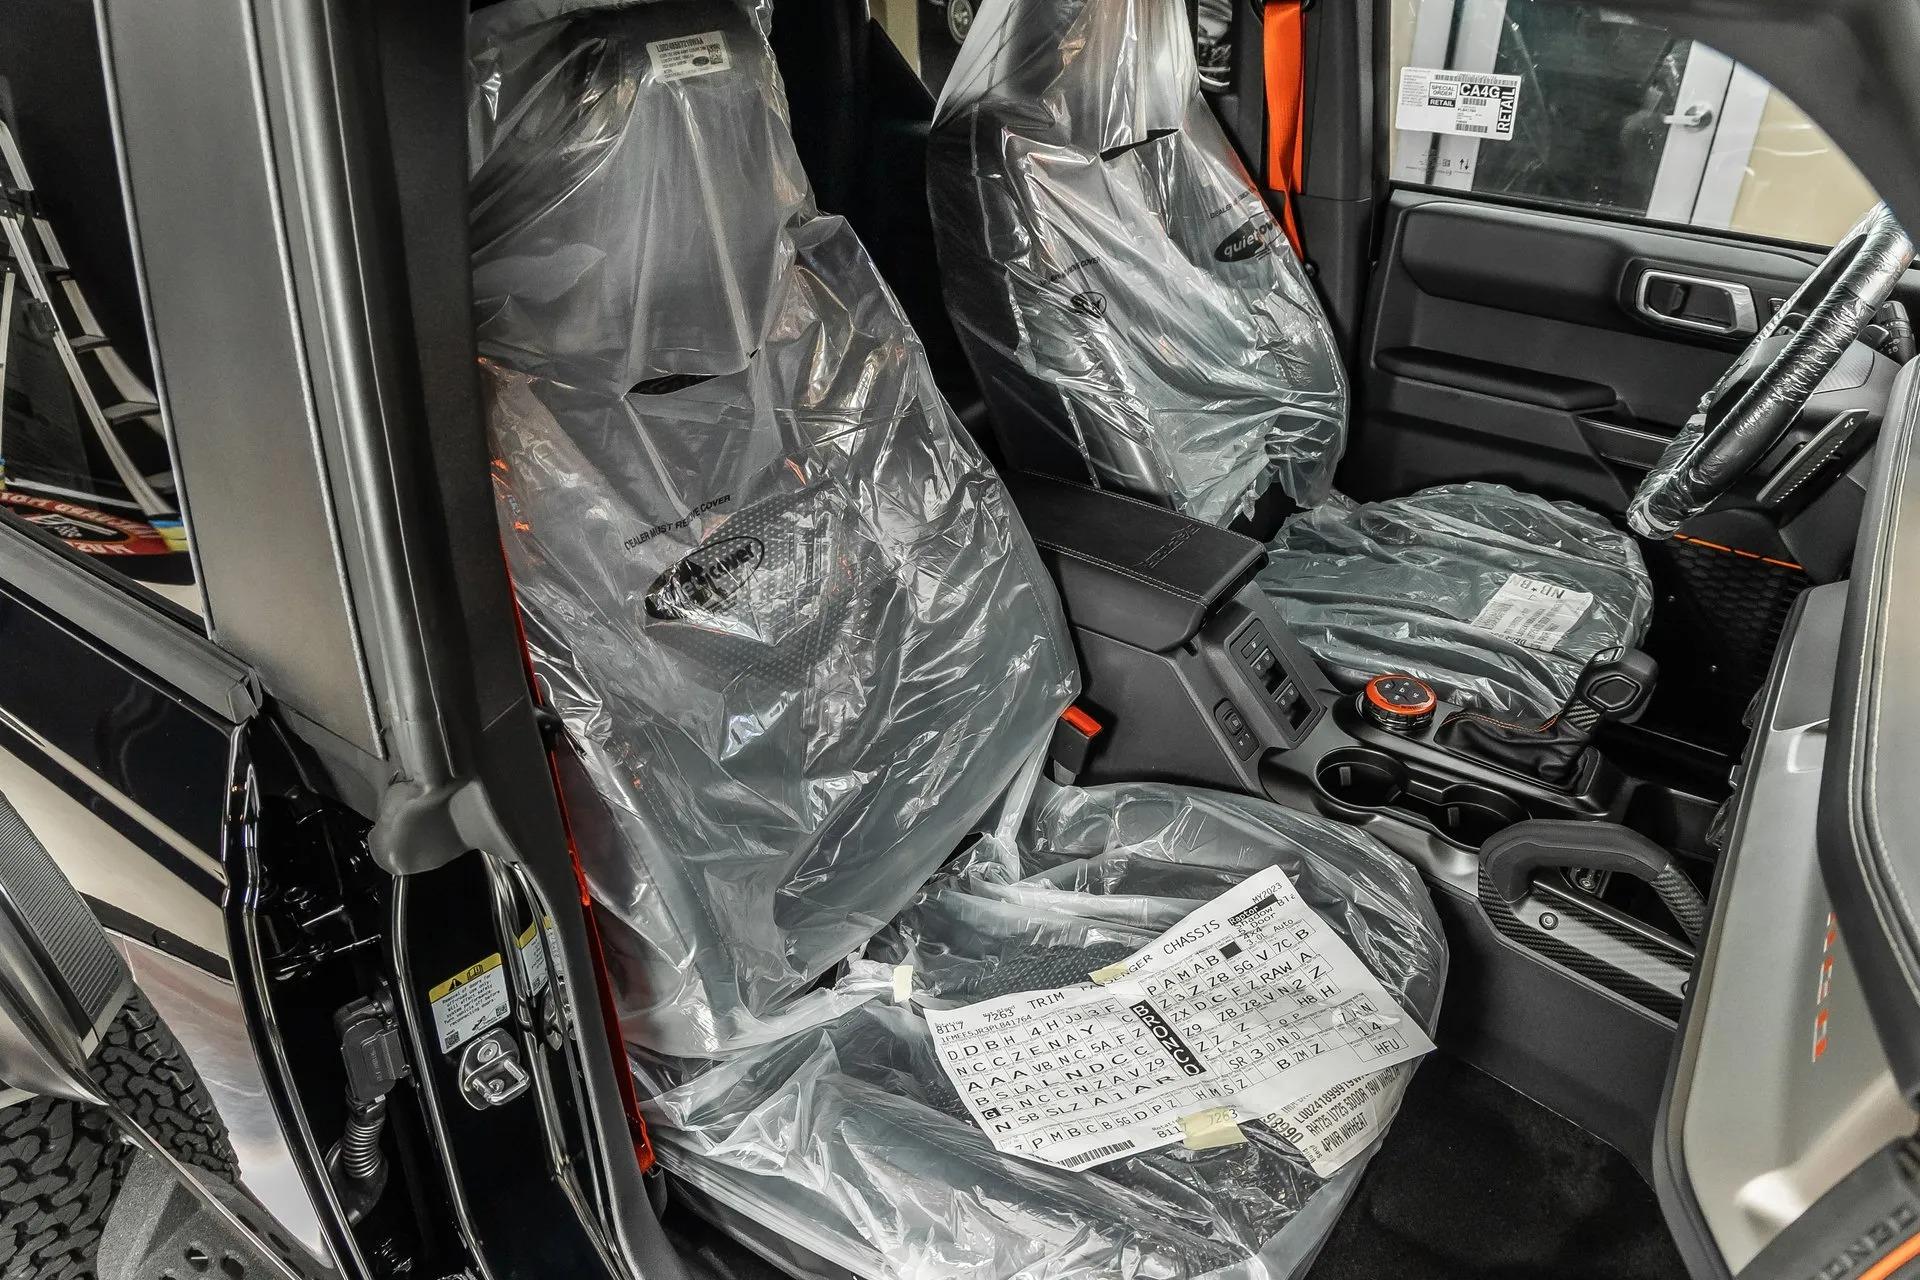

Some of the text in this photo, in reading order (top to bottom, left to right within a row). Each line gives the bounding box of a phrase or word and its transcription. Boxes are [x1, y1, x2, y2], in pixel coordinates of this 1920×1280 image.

[1430, 99, 1454, 107] RETAIL
[1460, 84, 1500, 98] CA4G
[1498, 88, 1516, 131] RETAIL
[624, 532, 651, 550] DEALER
[650, 522, 674, 538] MUST
[700, 494, 731, 514] COVER
[1229, 906, 1259, 925] Raptor
[1252, 882, 1283, 904] MY2023
[1234, 906, 1274, 929] Shadow
[1243, 926, 1262, 940] 4x4
[1251, 912, 1276, 928] Door
[1273, 919, 1294, 932] Auto
[936, 1021, 964, 1034] 8117
[984, 1010, 1014, 1022] 7263
[1027, 992, 1065, 1010] TRIM
[1163, 920, 1220, 955] CHASSIS
[1147, 955, 1220, 996] P A M A B
[1158, 999, 1172, 1010] Z
[1188, 985, 1202, 996] Z
[1206, 972, 1229, 988] Z8
[1234, 960, 1254, 975] 5G
[1256, 950, 1268, 961] V
[1272, 939, 1293, 952] 7C
[1295, 929, 1310, 940] B
[1170, 952, 1313, 1023] ZX D C F Z RAW A
[1183, 965, 1326, 1037] Z9 ZB Z8 V N 2 Z
[1196, 1041, 1210, 1052] Z
[1236, 1022, 1250, 1032] Z
[1297, 994, 1318, 1007] H8
[1320, 985, 1335, 997] H
[948, 1050, 958, 1060] D
[964, 1046, 978, 1056] D
[985, 1040, 998, 1050] B
[1004, 1036, 1015, 1045] H
[1031, 1027, 1042, 1036] 4
[1046, 1020, 1059, 1030] H
[956, 1015, 1133, 1076] N C C Z E N A Y C
[968, 1028, 1145, 1092] A A A VB N C 5A F Z
[1132, 1004, 1201, 1076] BRONCO
[1229, 1057, 1248, 1070] SR
[1251, 1048, 1264, 1059] 3
[1266, 1043, 1276, 1052] D
[1277, 1036, 1290, 1047] N
[1374, 1038, 1400, 1055] HFU
[975, 1097, 990, 1106] B
[1014, 1085, 1036, 1094] LA
[1065, 1069, 1083, 1080] N
[1089, 1063, 1105, 1074] D
[1112, 1054, 1128, 1065] C
[1134, 1045, 1148, 1056] C
[985, 1058, 1165, 1118] G S N C C N Z A V Z9
[1032, 1138, 1043, 1149] P
[1050, 1132, 1064, 1142] M
[1067, 1128, 1081, 1137] B
[1086, 1124, 1098, 1134] C
[1101, 1121, 1113, 1130] B
[1115, 1116, 1131, 1127] 5G
[1134, 1111, 1148, 1121] D
[1152, 1104, 1163, 1114] P
[1167, 1100, 1178, 1108] Z
[1195, 1090, 1207, 1100] H
[1208, 1088, 1222, 1098] M
[1224, 1084, 1235, 1095] S
[1236, 1079, 1248, 1089] Z
[1277, 1058, 1291, 1070] B
[1310, 1043, 1325, 1054] Z
[994, 1122, 1012, 1133] N
[1018, 1113, 1040, 1125] SB
[1046, 1103, 1083, 1117] SLZ
[1094, 1097, 1108, 1106] A
[1134, 1085, 1151, 1095] A
[1305, 1113, 1331, 1136] RH725
[1329, 1102, 1346, 1125] U725
[1366, 1081, 1381, 1097] 19W
[1321, 1130, 1345, 1154] 4PWR
